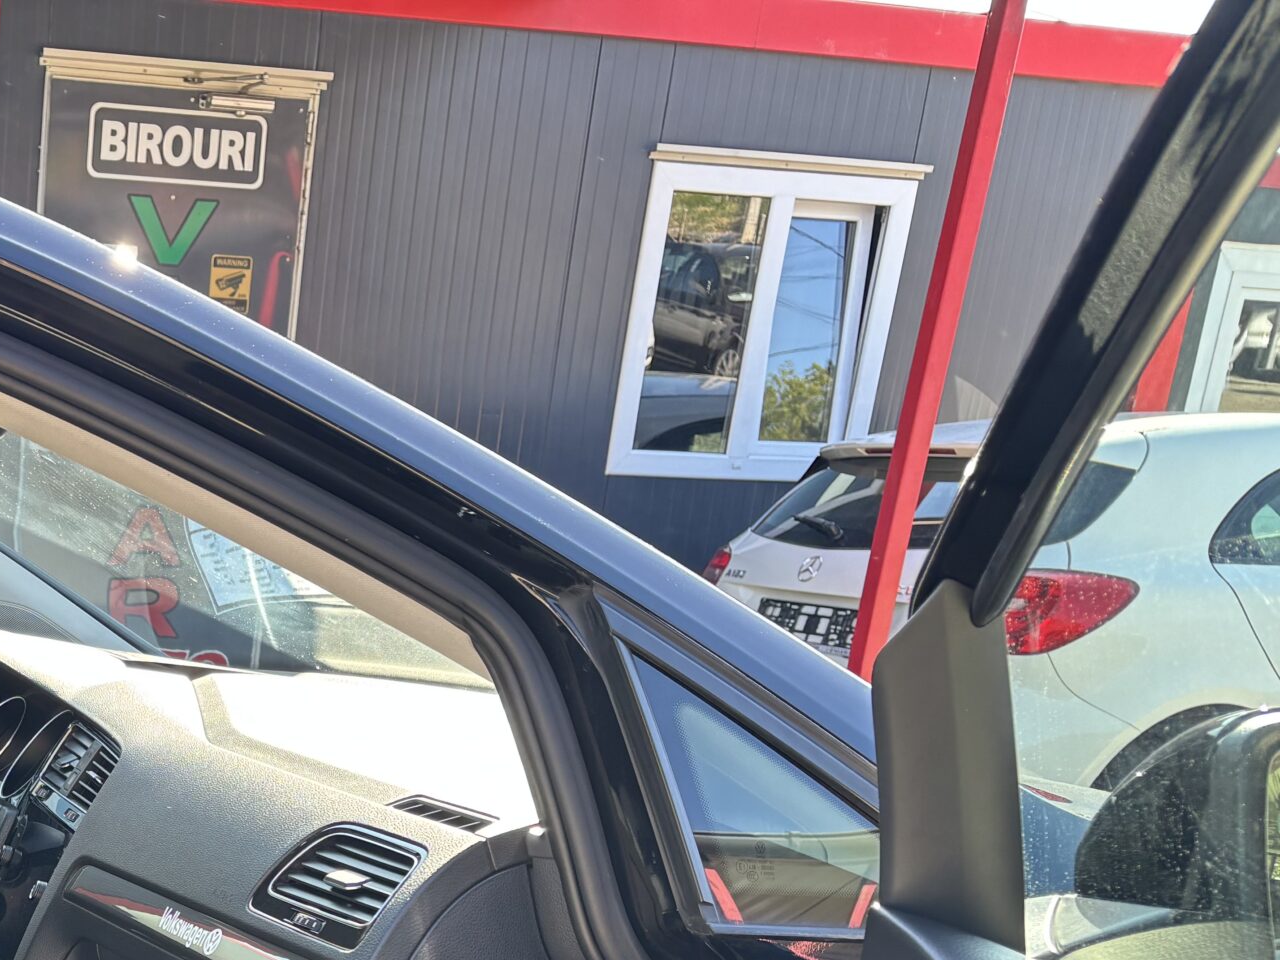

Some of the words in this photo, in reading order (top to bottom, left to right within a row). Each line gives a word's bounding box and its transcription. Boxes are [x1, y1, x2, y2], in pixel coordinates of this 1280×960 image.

[100, 119, 257, 172] BIROURI
[216, 258, 248, 267] WARNING
[159, 906, 209, 948] Volkswagen
